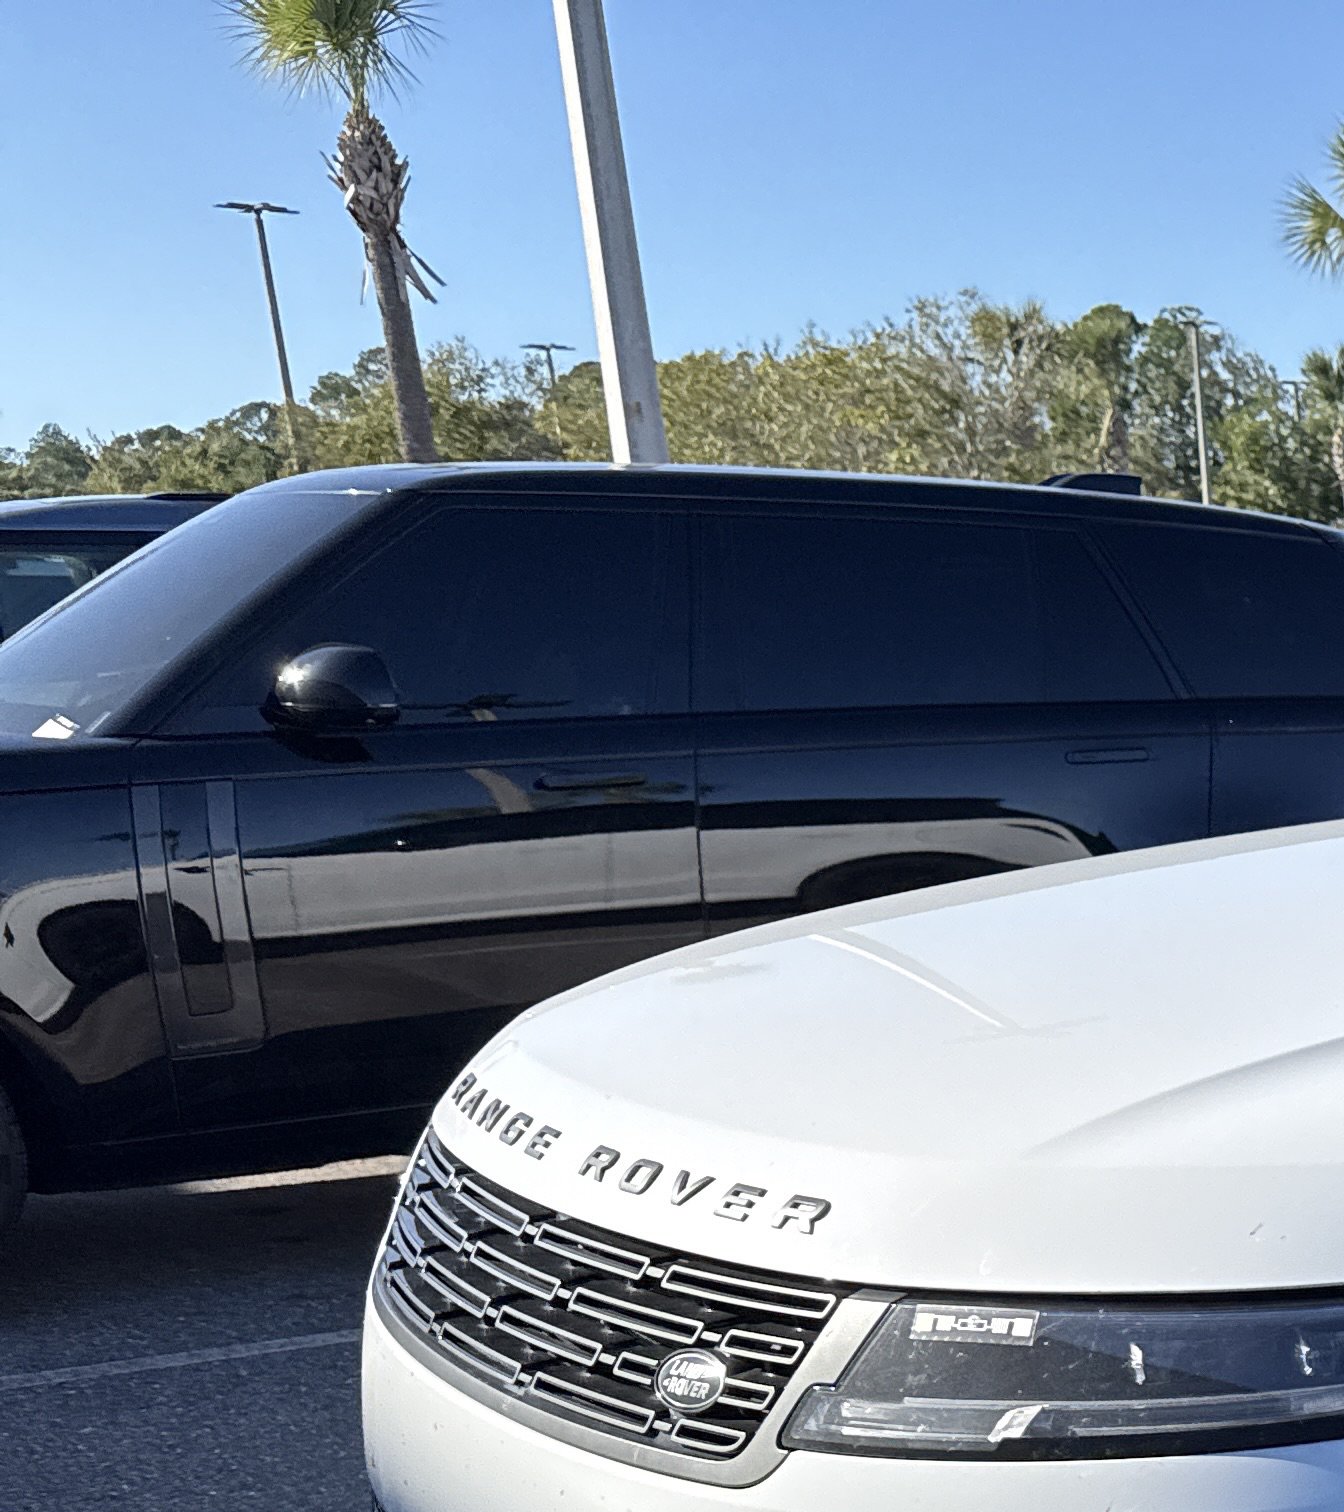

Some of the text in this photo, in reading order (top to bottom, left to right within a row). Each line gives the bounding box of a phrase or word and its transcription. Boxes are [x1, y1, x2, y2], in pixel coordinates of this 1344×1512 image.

[451, 1072, 832, 1235] RANGE ROVER
[667, 1376, 710, 1400] ROVER
